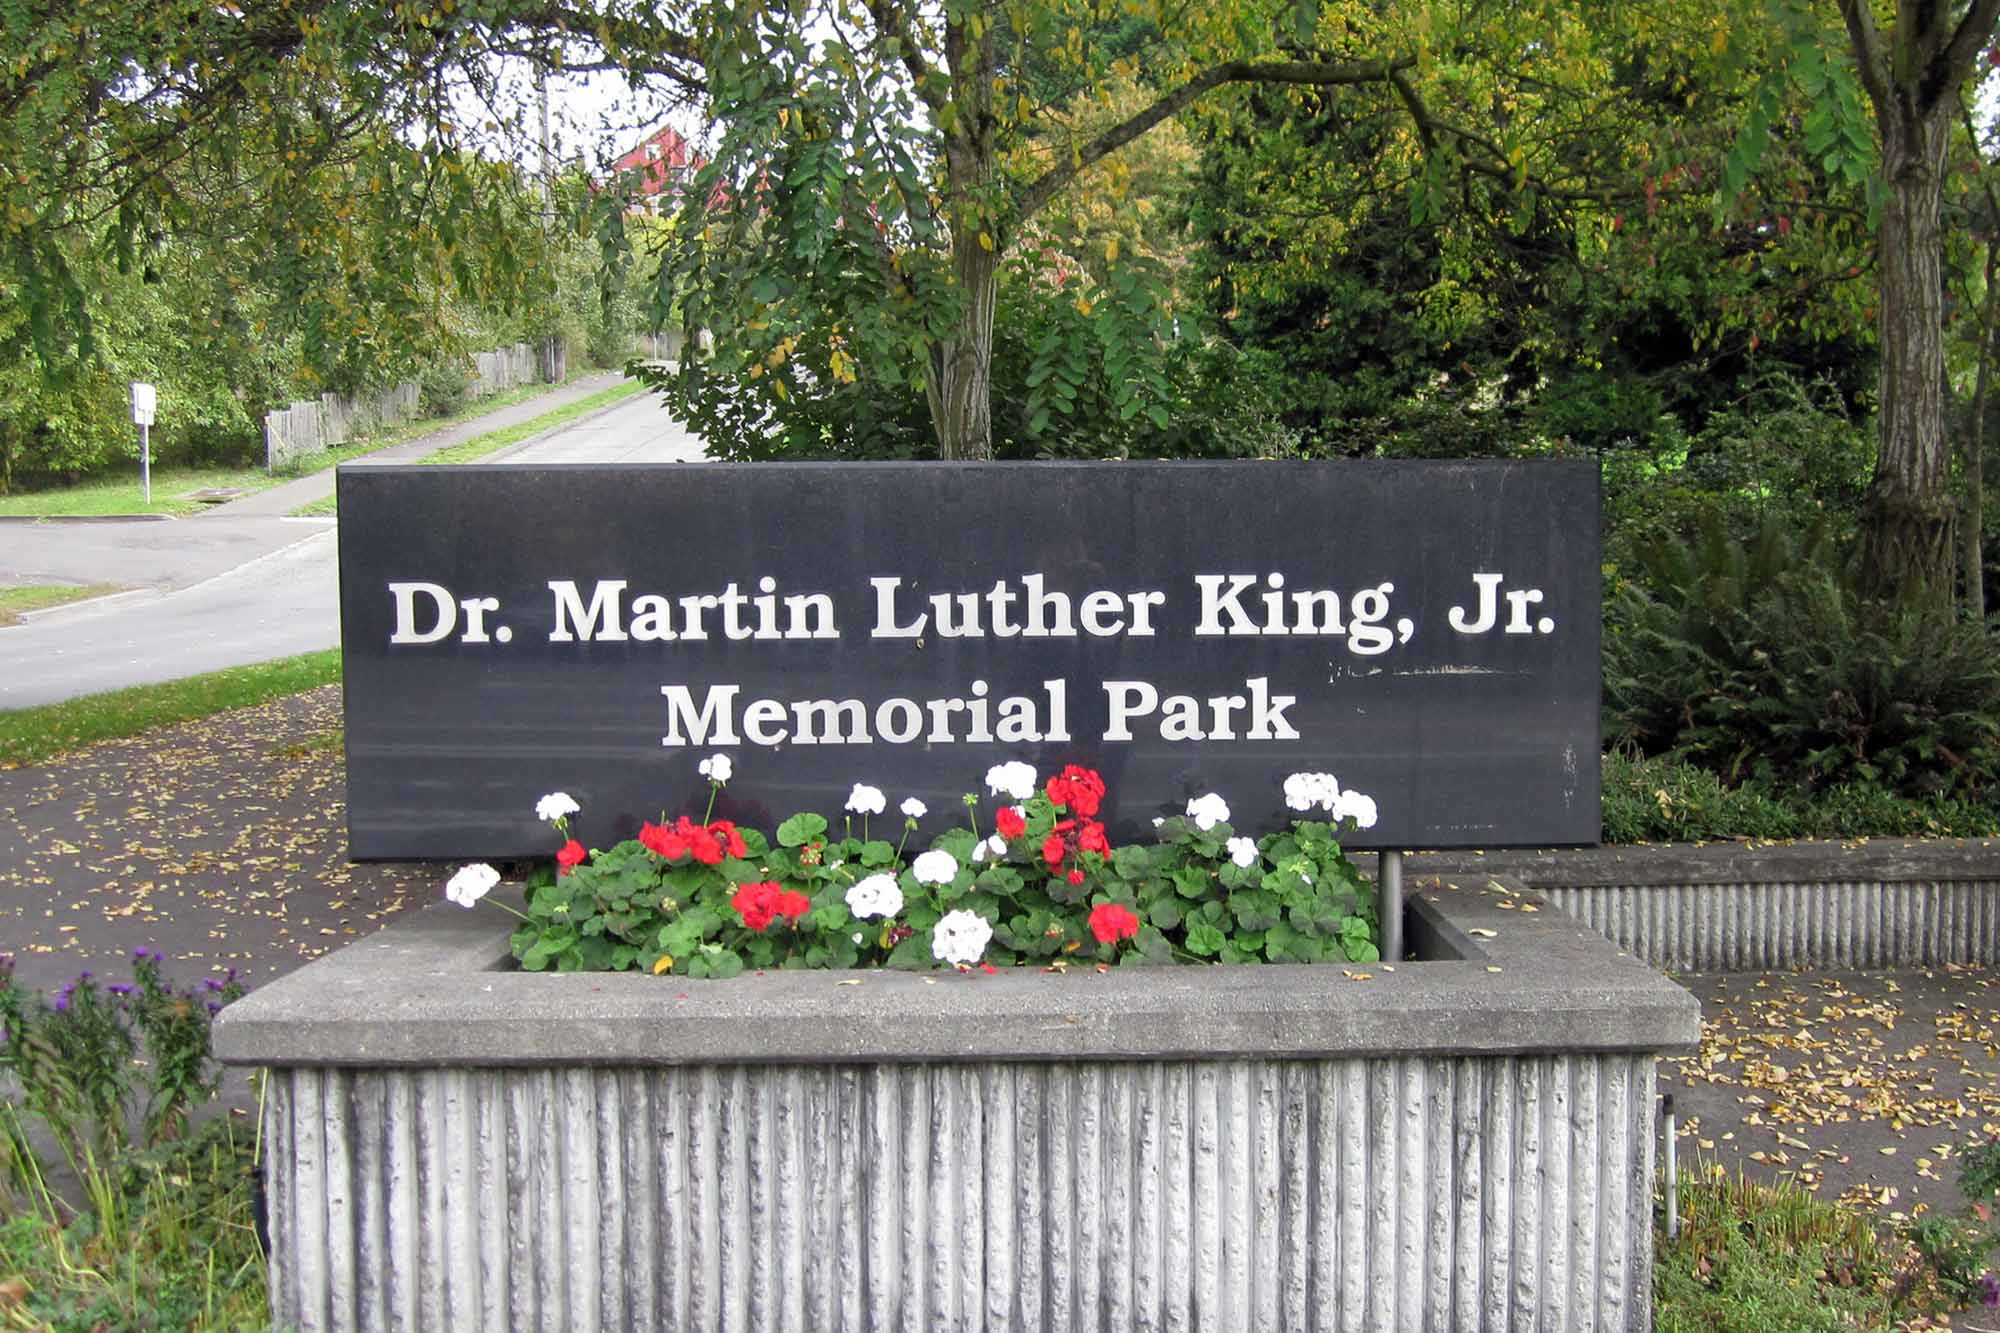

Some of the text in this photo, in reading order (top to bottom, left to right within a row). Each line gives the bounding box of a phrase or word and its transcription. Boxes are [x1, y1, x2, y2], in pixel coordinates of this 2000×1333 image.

[388, 573, 1555, 655] Dr. Martin Luther King, Jr.
[660, 677, 1301, 746] Memorial Park
